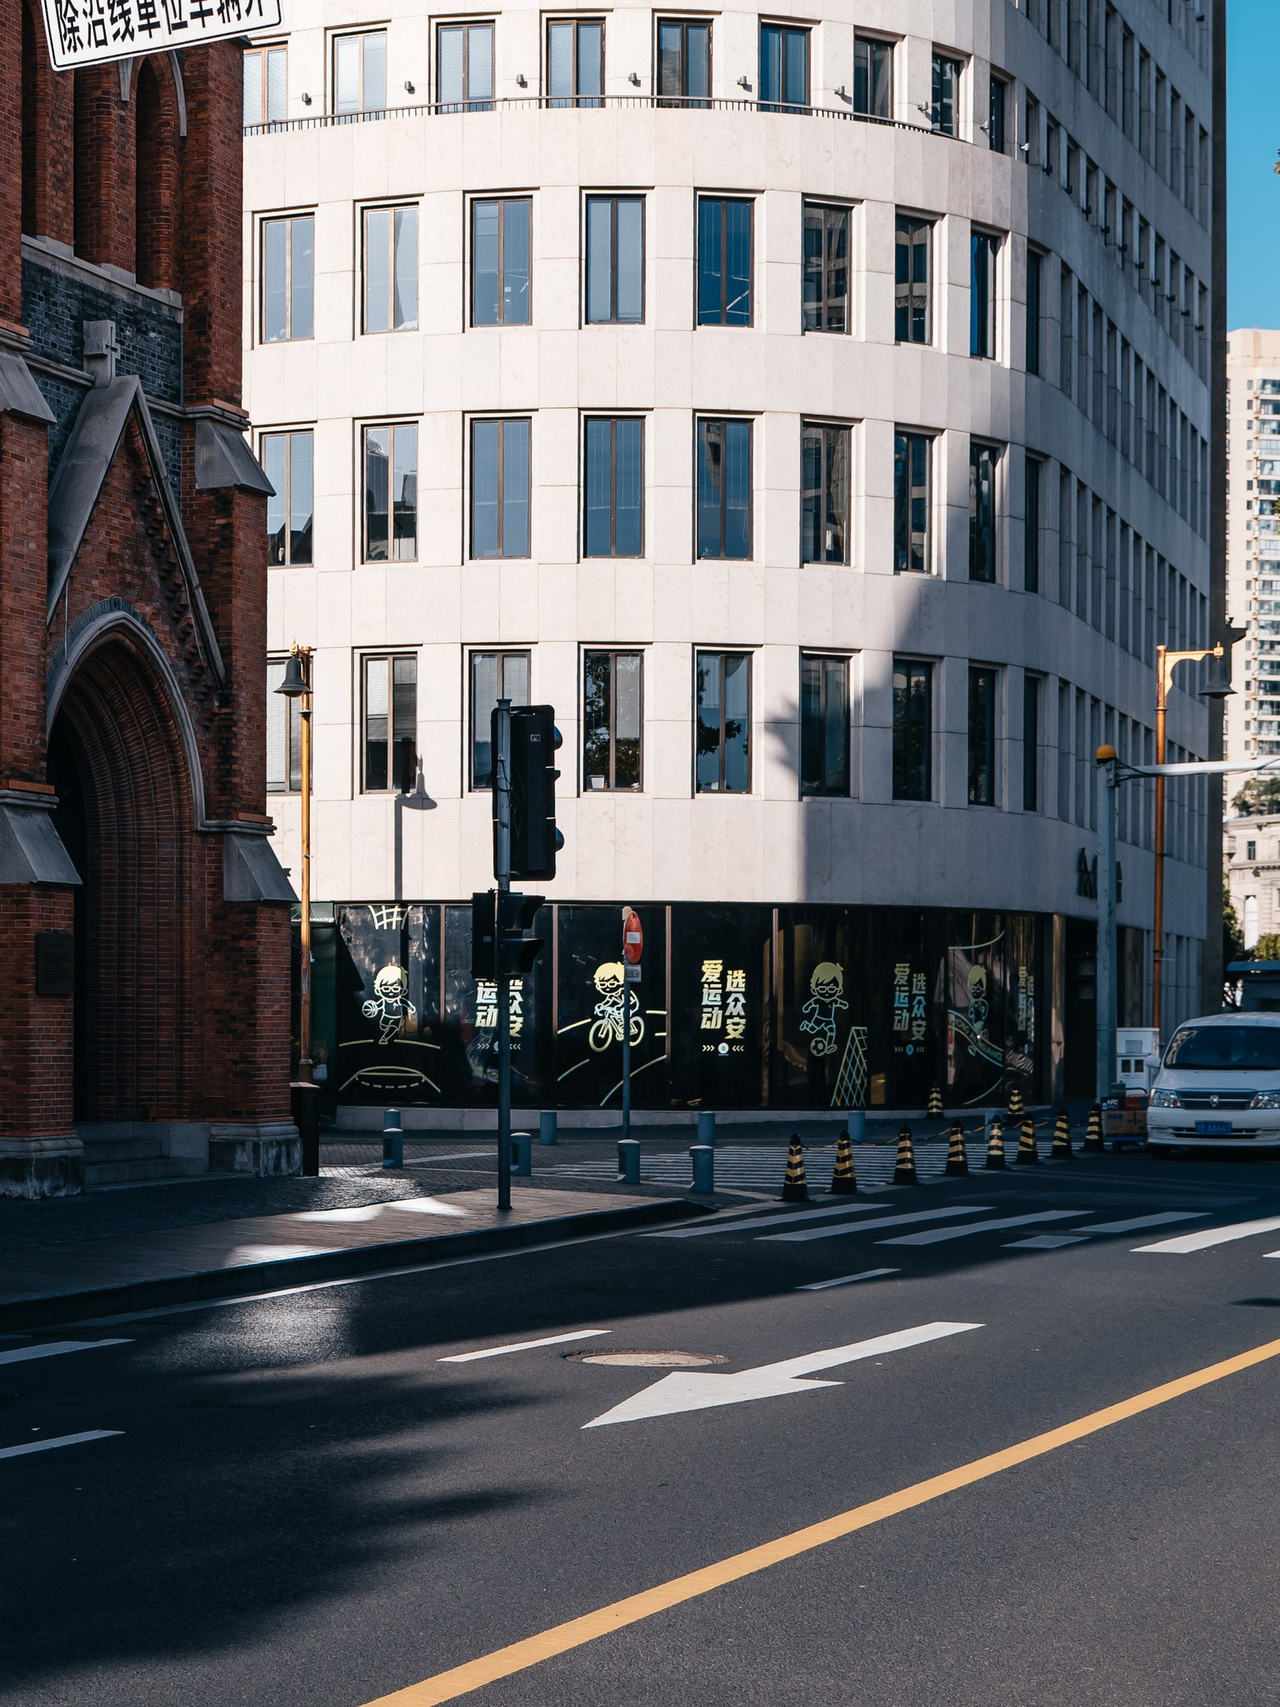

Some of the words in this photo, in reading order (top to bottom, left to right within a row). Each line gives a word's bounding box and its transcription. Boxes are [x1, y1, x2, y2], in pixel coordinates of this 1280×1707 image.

[475, 977, 499, 1027] 运动
[700, 959, 723, 1030] 爱运动
[724, 969, 747, 1039] 选众安
[893, 962, 910, 1031] 爱运动
[911, 972, 927, 1040] 选众安
